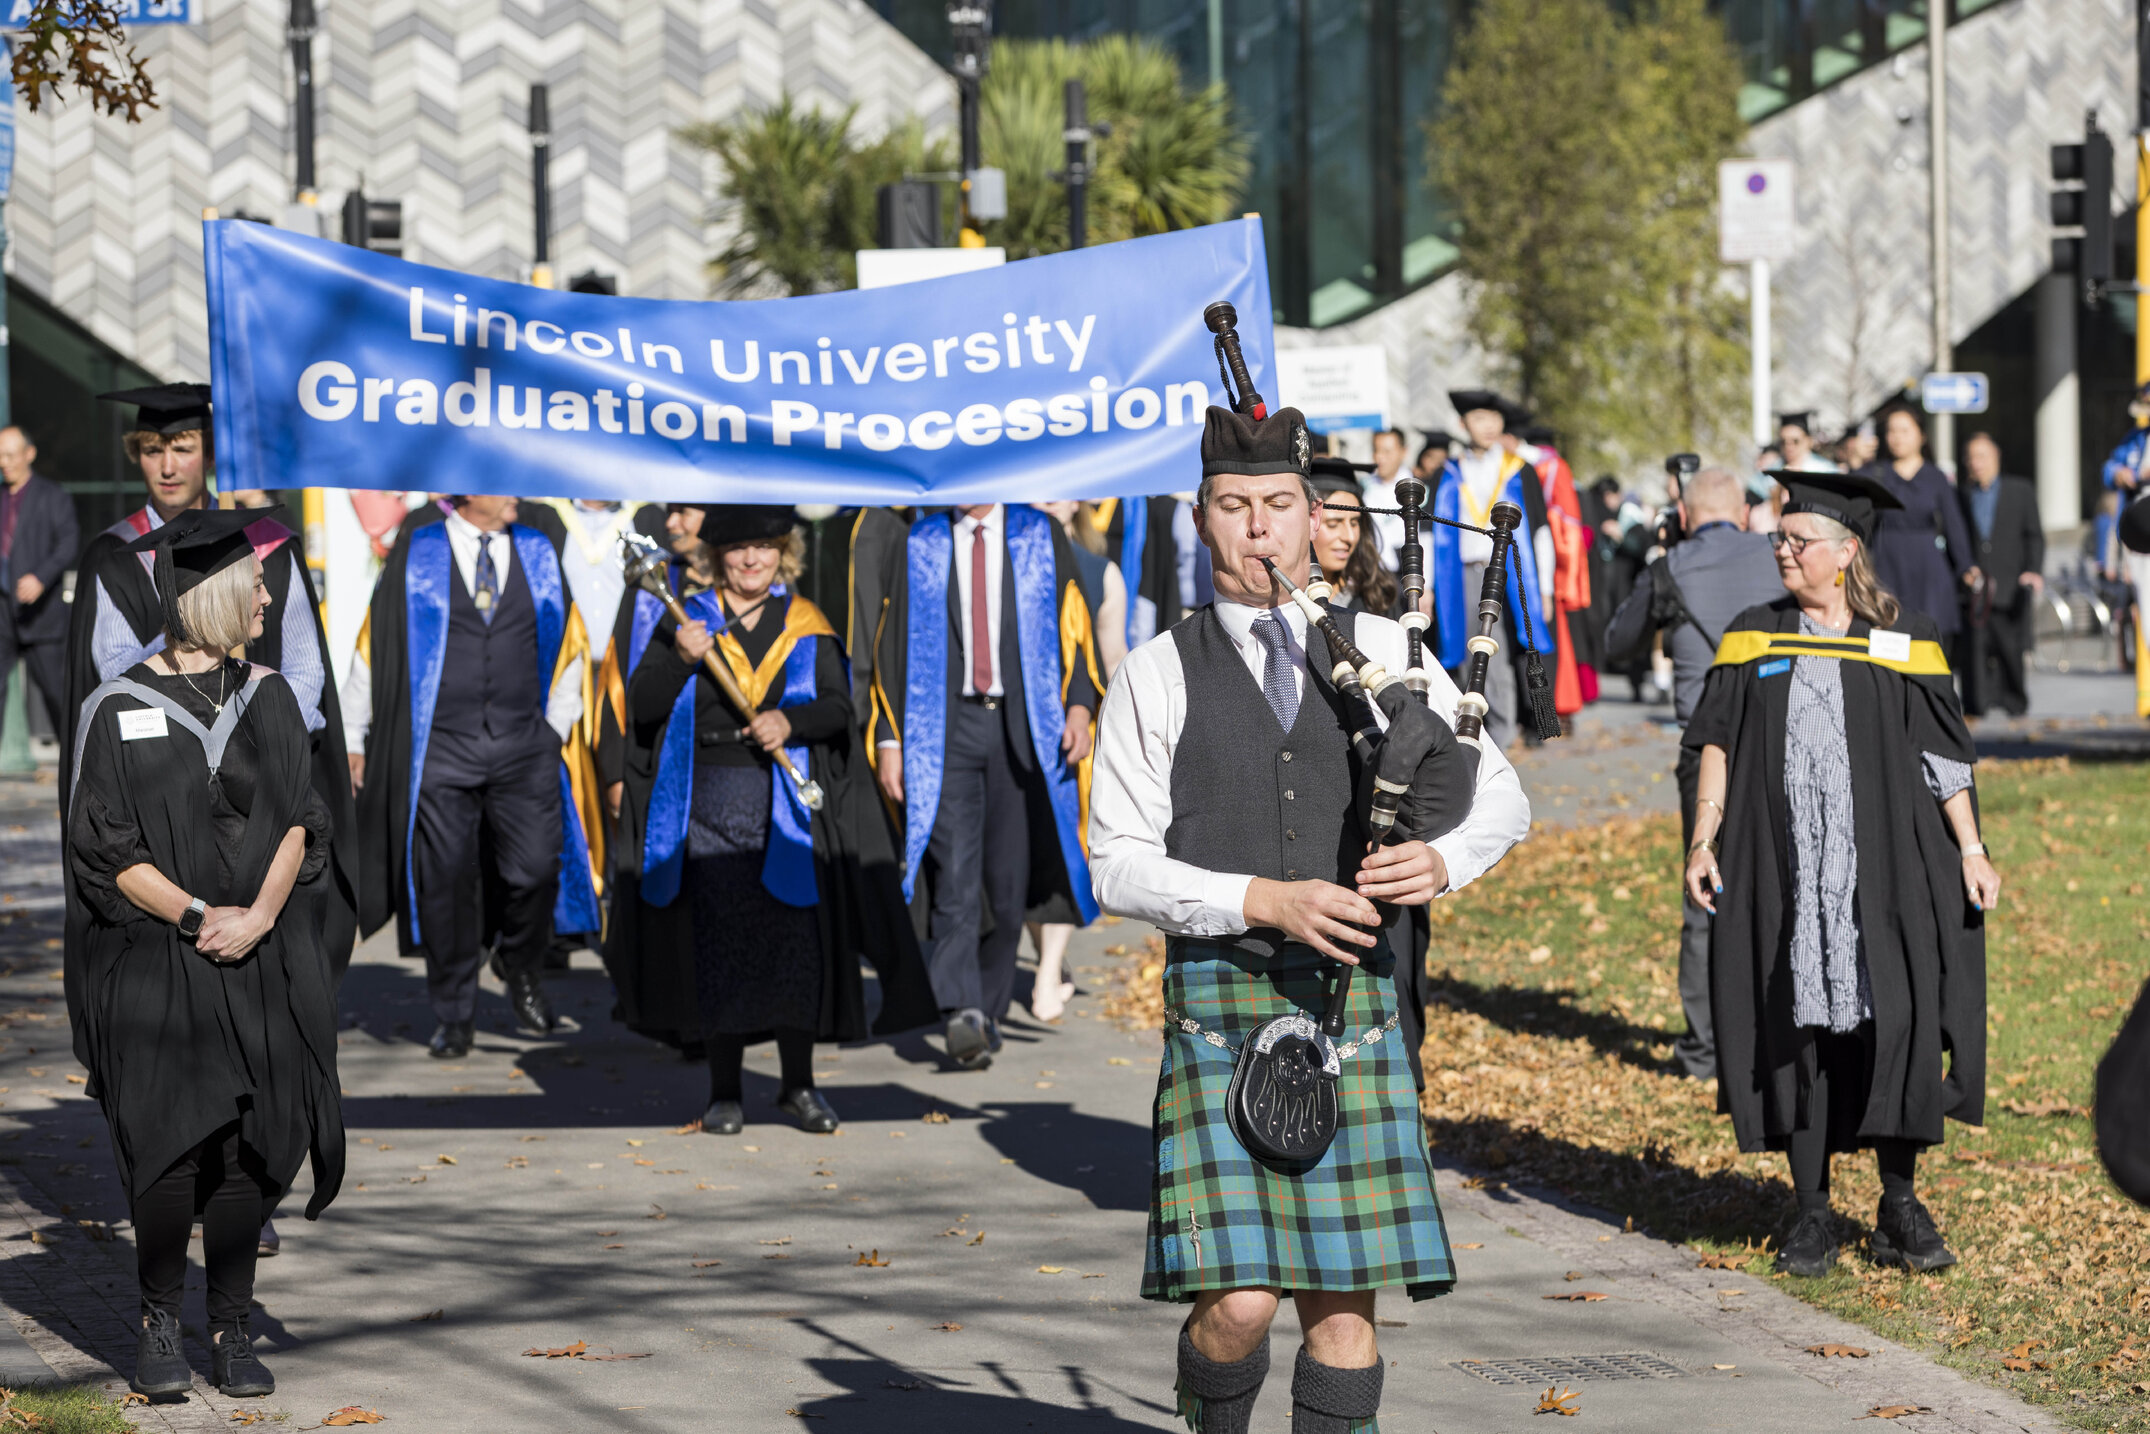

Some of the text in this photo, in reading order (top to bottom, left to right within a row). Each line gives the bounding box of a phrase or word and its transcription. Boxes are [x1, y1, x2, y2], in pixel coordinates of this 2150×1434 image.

[409, 286, 1096, 385] Lincoln University
[298, 360, 1209, 451] Graduation Procession
